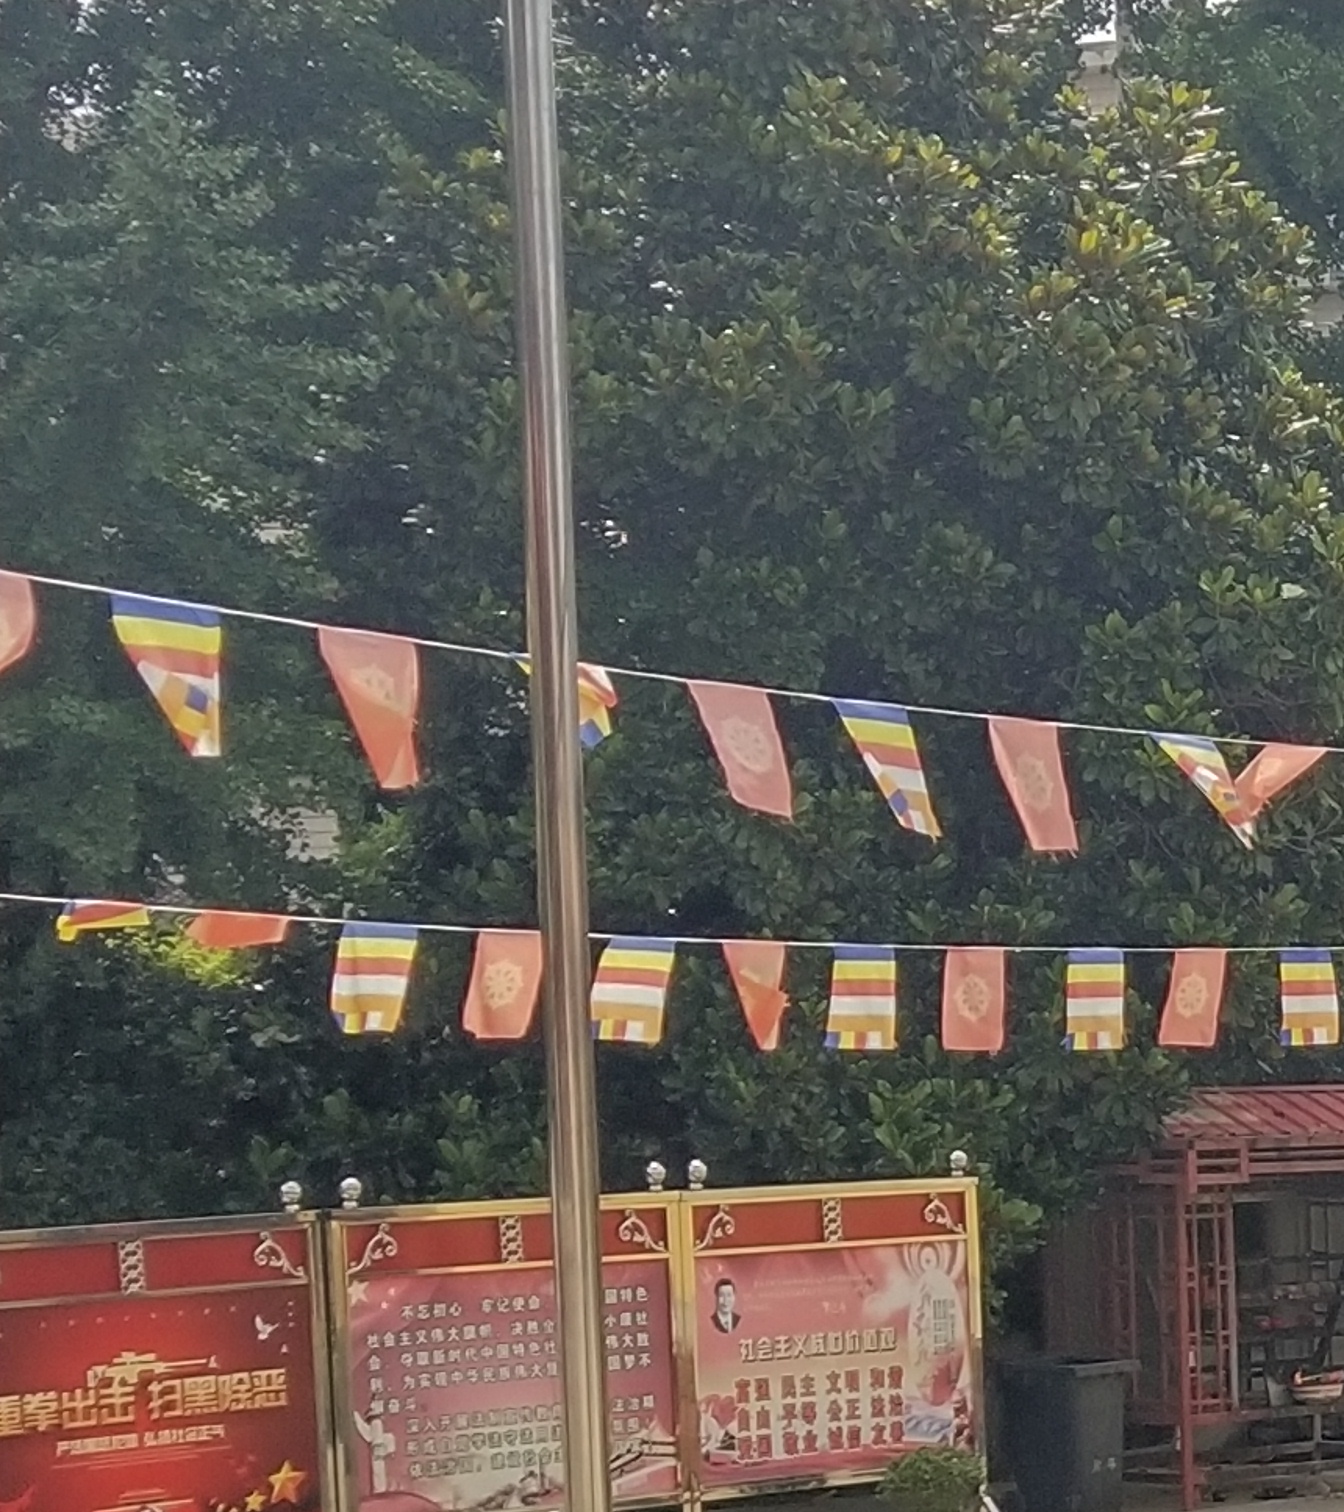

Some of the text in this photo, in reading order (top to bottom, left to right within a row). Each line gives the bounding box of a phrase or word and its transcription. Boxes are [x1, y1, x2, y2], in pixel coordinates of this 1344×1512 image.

[401, 1301, 462, 1320] 不忘初心
[605, 1286, 648, 1304] 国特色
[604, 1311, 648, 1328] 小康社
[606, 1332, 650, 1350] 伟大胜
[738, 1327, 898, 1363] 社会主义核心价值观
[607, 1352, 651, 1371] 国梦不
[0, 1368, 289, 1436] 重拳出击 扫黑除恶
[734, 1365, 904, 1404] 富强 民主 文明 和谐
[736, 1393, 904, 1432] 自由 平等 公正 法治
[737, 1420, 906, 1461] 爱国 敬业 诚信 友善
